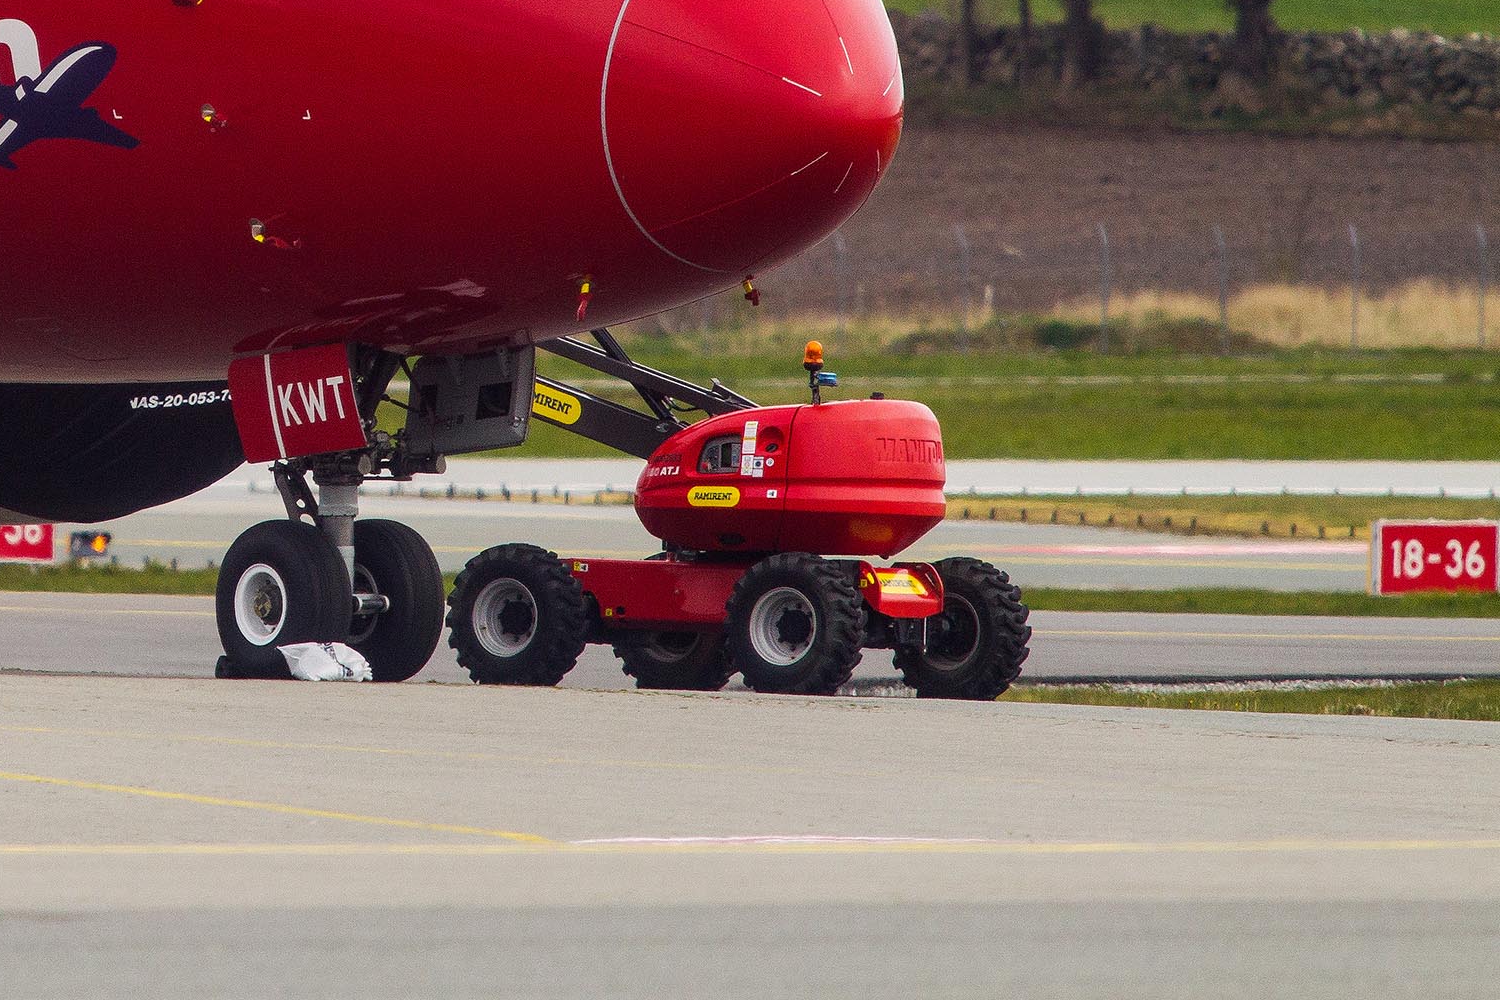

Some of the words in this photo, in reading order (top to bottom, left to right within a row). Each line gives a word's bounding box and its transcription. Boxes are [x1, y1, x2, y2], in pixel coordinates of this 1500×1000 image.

[277, 376, 345, 427] KWT
[660, 466, 680, 476] ATJ
[694, 492, 733, 501] RAMIRENT
[1391, 539, 1485, 578] 18-36
